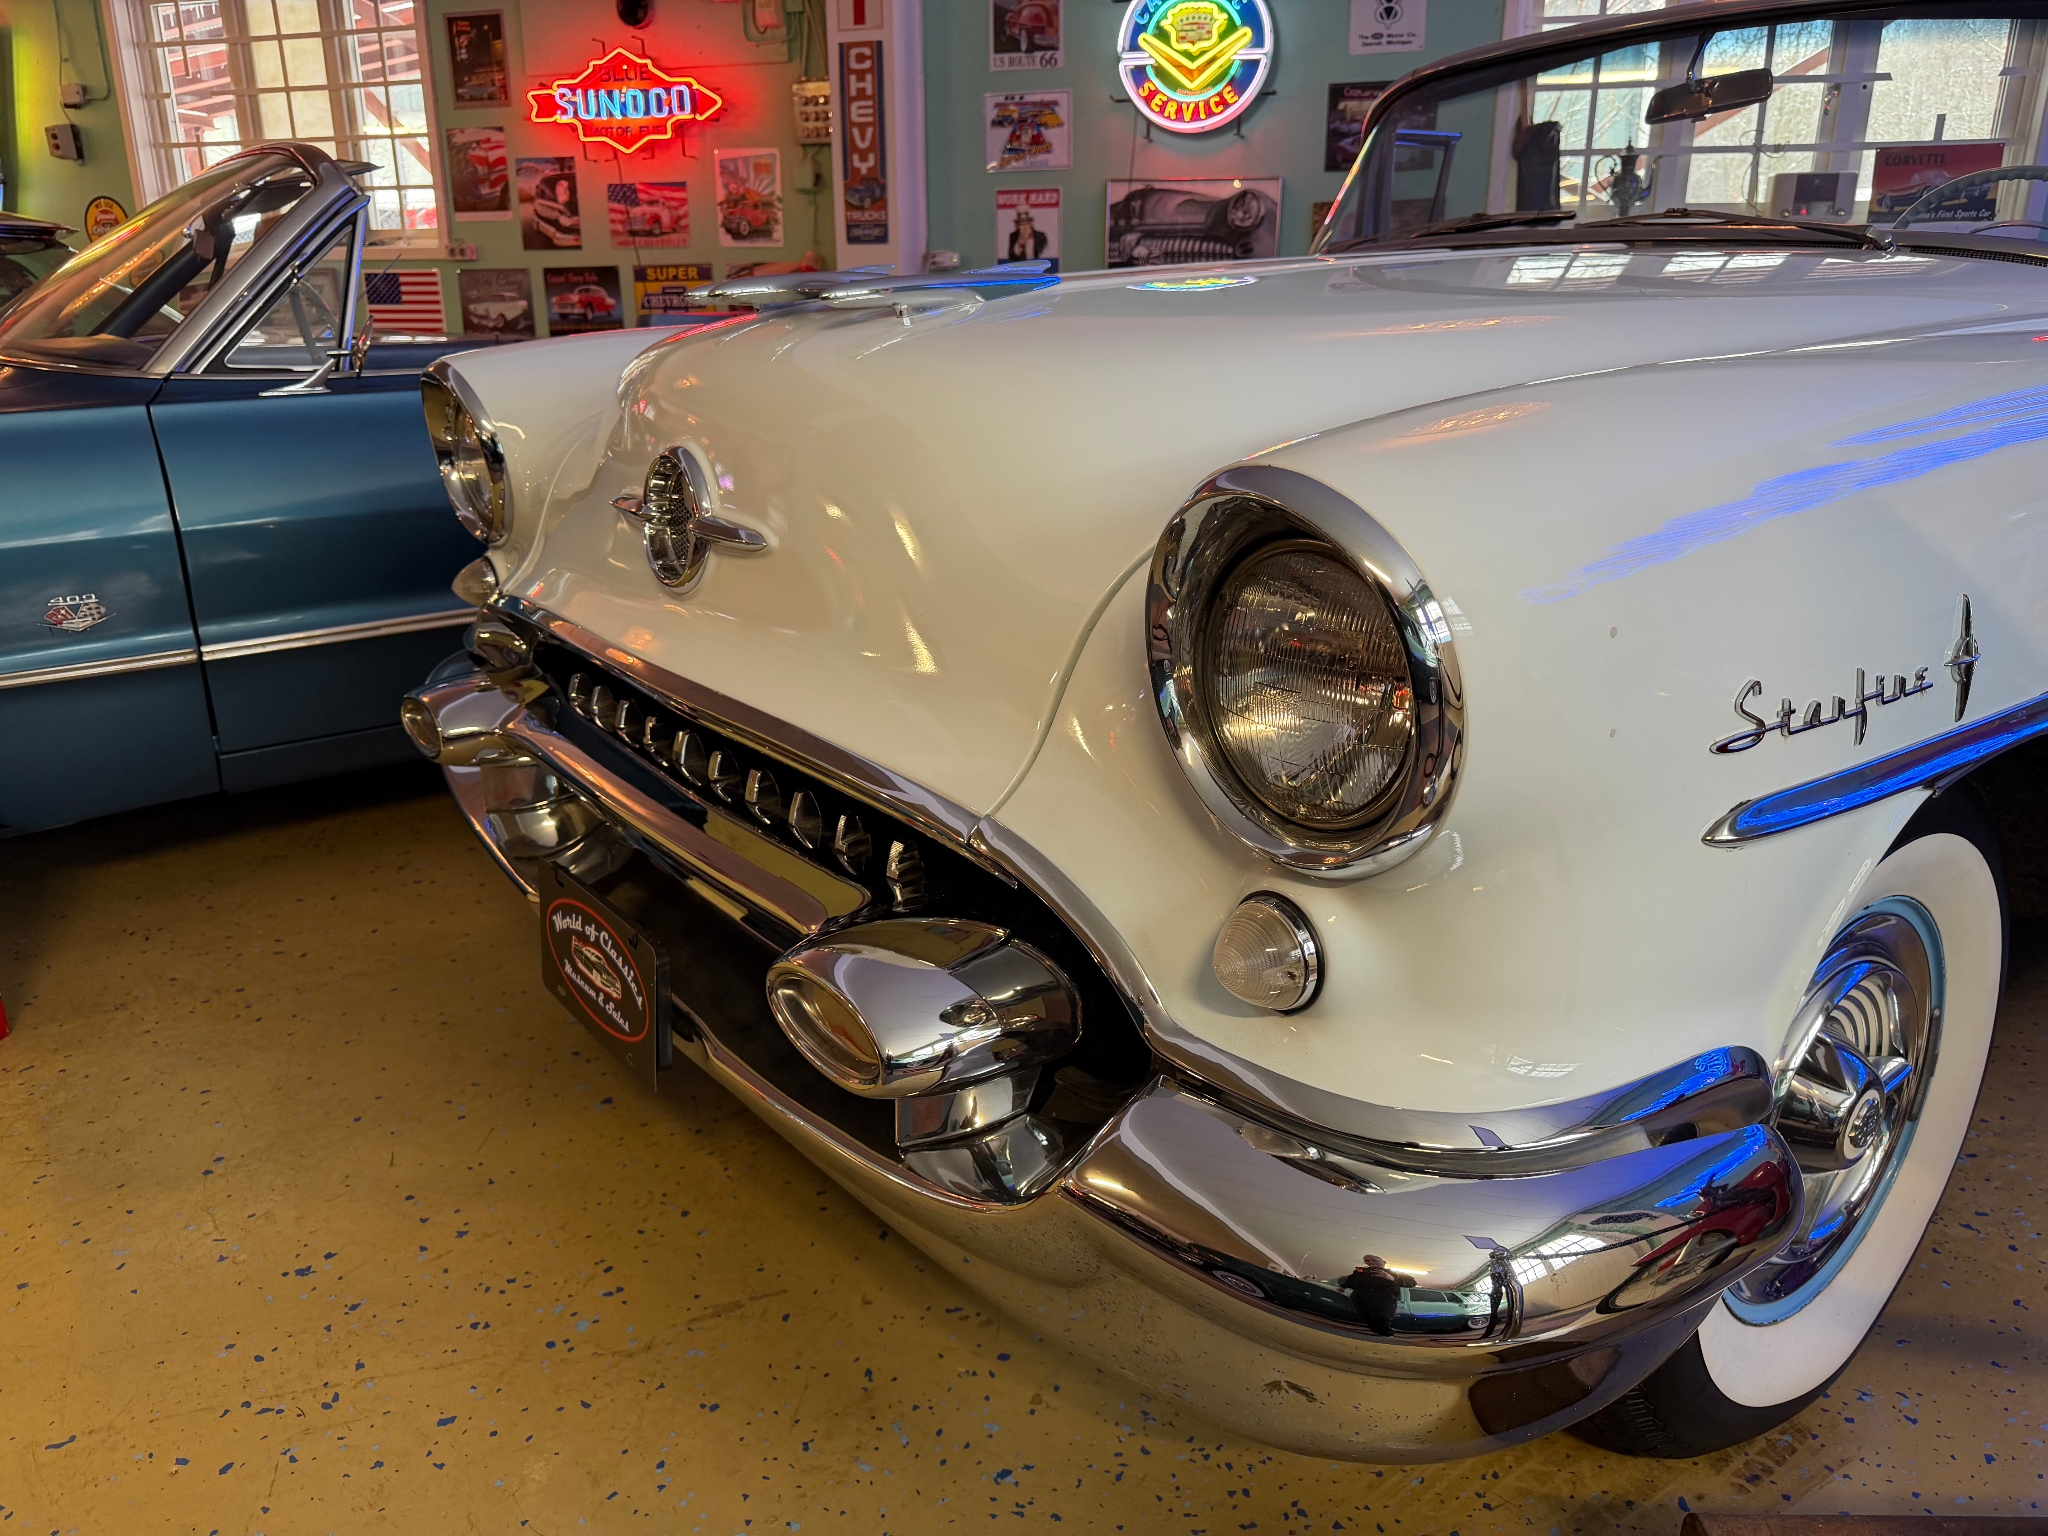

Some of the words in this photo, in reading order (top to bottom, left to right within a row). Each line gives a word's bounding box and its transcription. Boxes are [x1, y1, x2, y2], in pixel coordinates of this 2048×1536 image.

[600, 64, 653, 82] BLUE
[1007, 54, 1038, 67] ROUTE
[1039, 51, 1058, 68] 66
[554, 84, 692, 121] SUNOCO
[848, 47, 876, 176] CHEVY
[1138, 79, 1239, 123] SERVICE
[1884, 153, 1947, 167] CORVETTE
[846, 210, 887, 221] TRUCKS
[1936, 209, 1955, 218] First
[1955, 208, 1978, 220] Sports
[646, 266, 699, 282] SUPER
[1708, 666, 1934, 754] Starfire
[552, 909, 583, 933] World
[585, 922, 599, 943] of
[599, 930, 643, 1011] Classics
[563, 957, 598, 1000] Museum
[597, 990, 605, 1009] &
[605, 1000, 630, 1033] Sales
